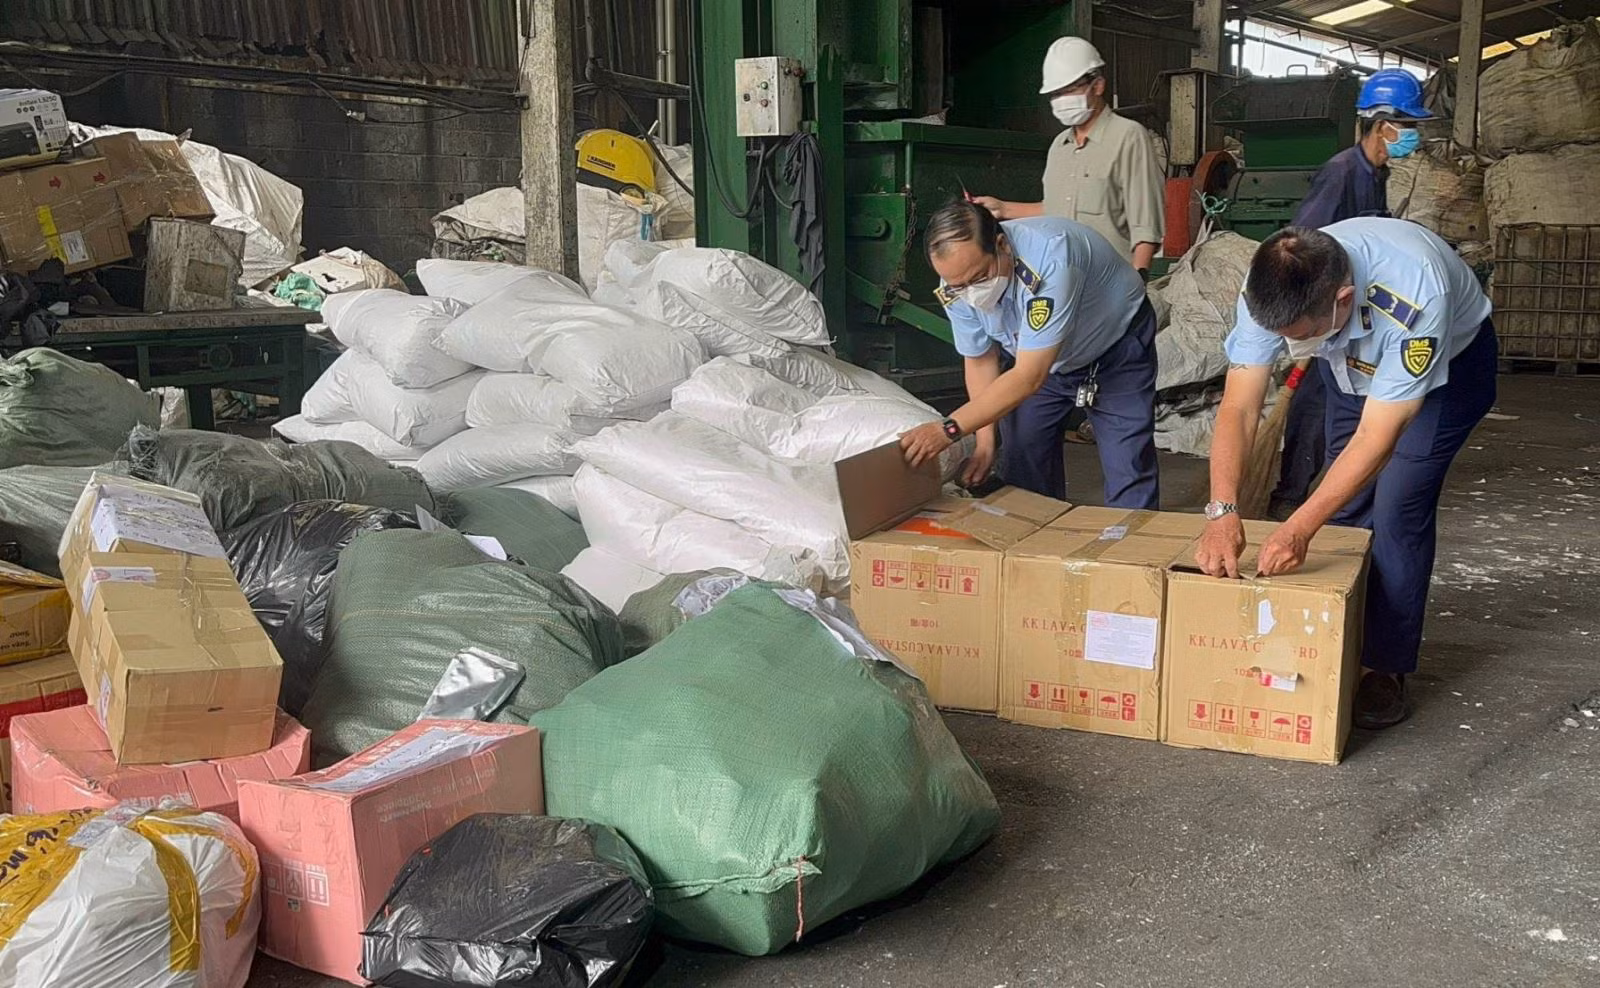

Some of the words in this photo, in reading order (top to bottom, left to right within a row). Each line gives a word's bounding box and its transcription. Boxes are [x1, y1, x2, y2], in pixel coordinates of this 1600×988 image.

[1410, 339, 1429, 348] DMS
[1023, 617, 1039, 629] KK
[1043, 620, 1076, 633] LAVA
[873, 639, 924, 653] CUSTAR
[928, 643, 960, 656] LAVA
[1189, 634, 1207, 647] KK
[1212, 636, 1249, 652] LAVA
[964, 648, 980, 658] KK
